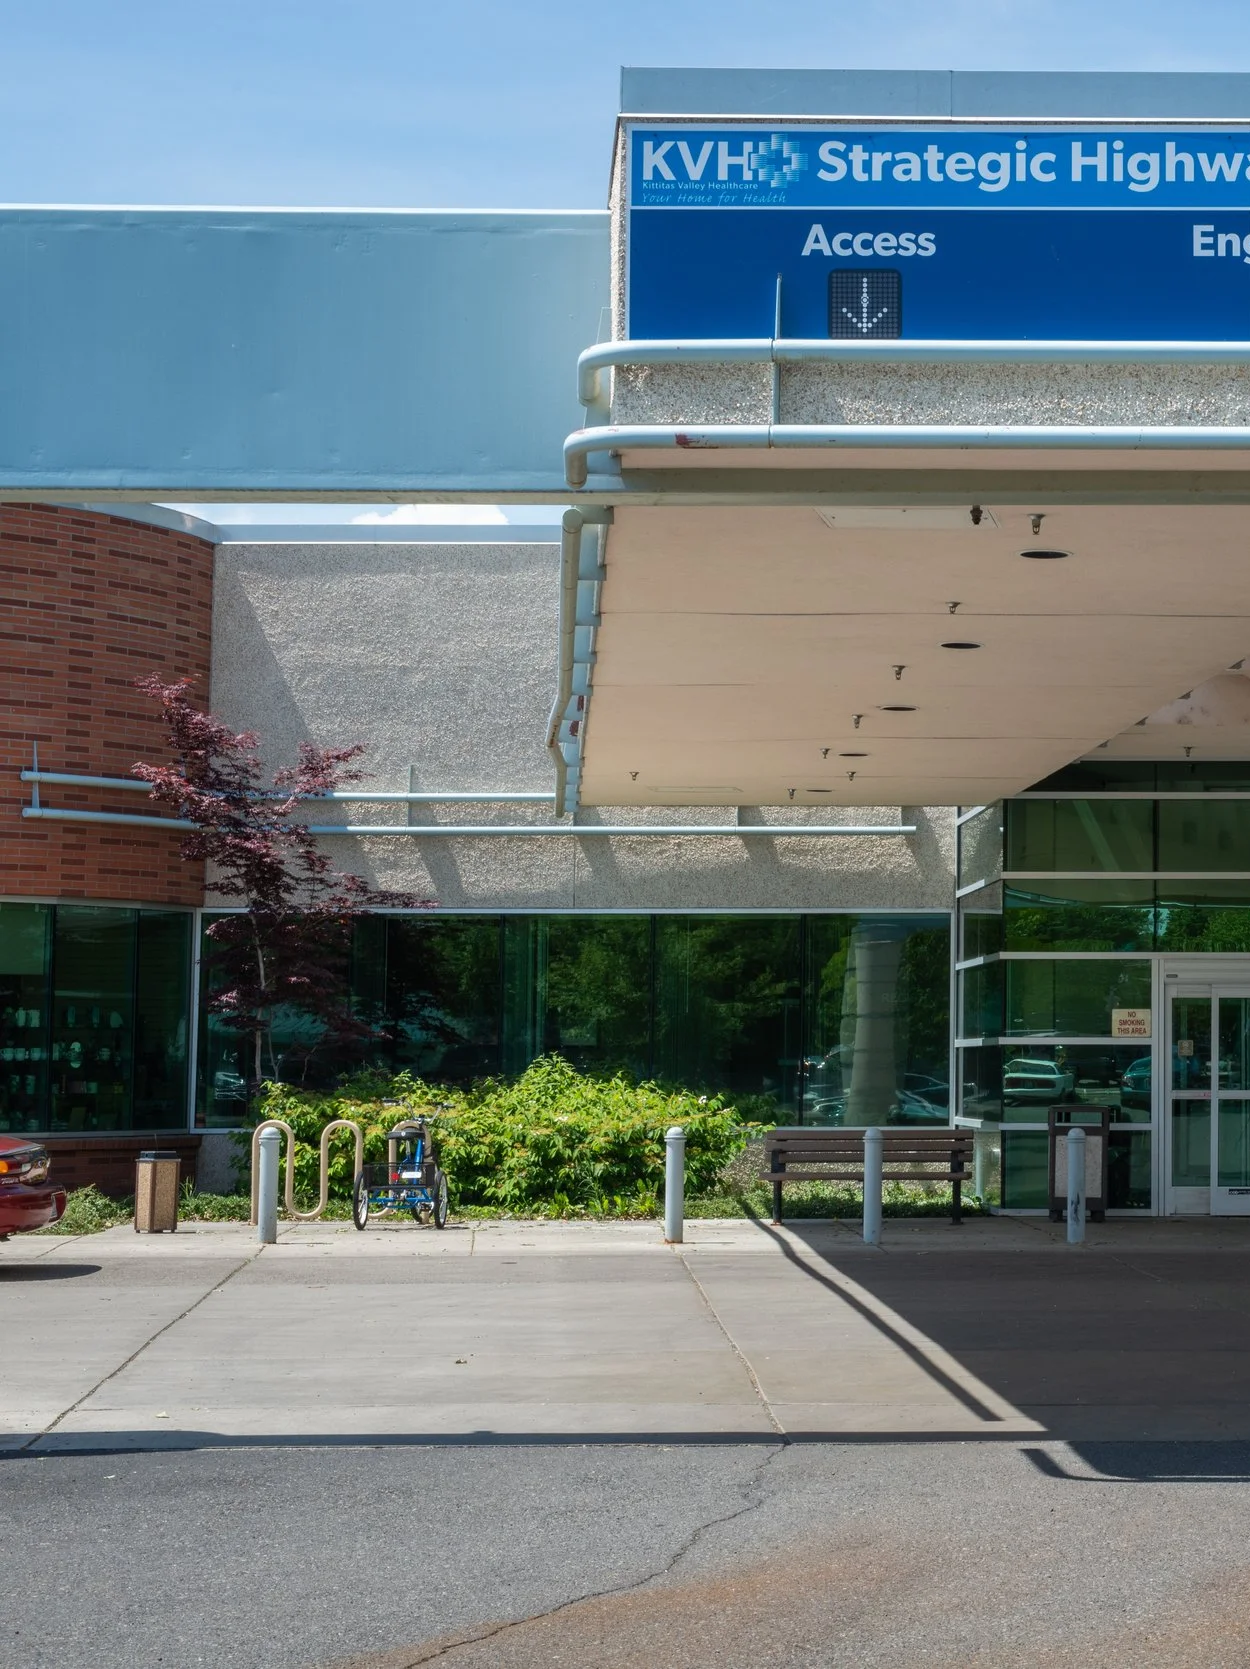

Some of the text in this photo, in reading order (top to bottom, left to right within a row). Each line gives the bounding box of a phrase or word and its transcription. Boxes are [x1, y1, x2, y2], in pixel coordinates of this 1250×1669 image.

[642, 140, 754, 181] KVH
[816, 139, 1057, 192] Strategic
[642, 181, 759, 192] Kittitas Valley Healthcare
[642, 191, 786, 206] Your Home for Health
[800, 223, 937, 257] Access
[1117, 1027, 1147, 1035] THIS AREA
